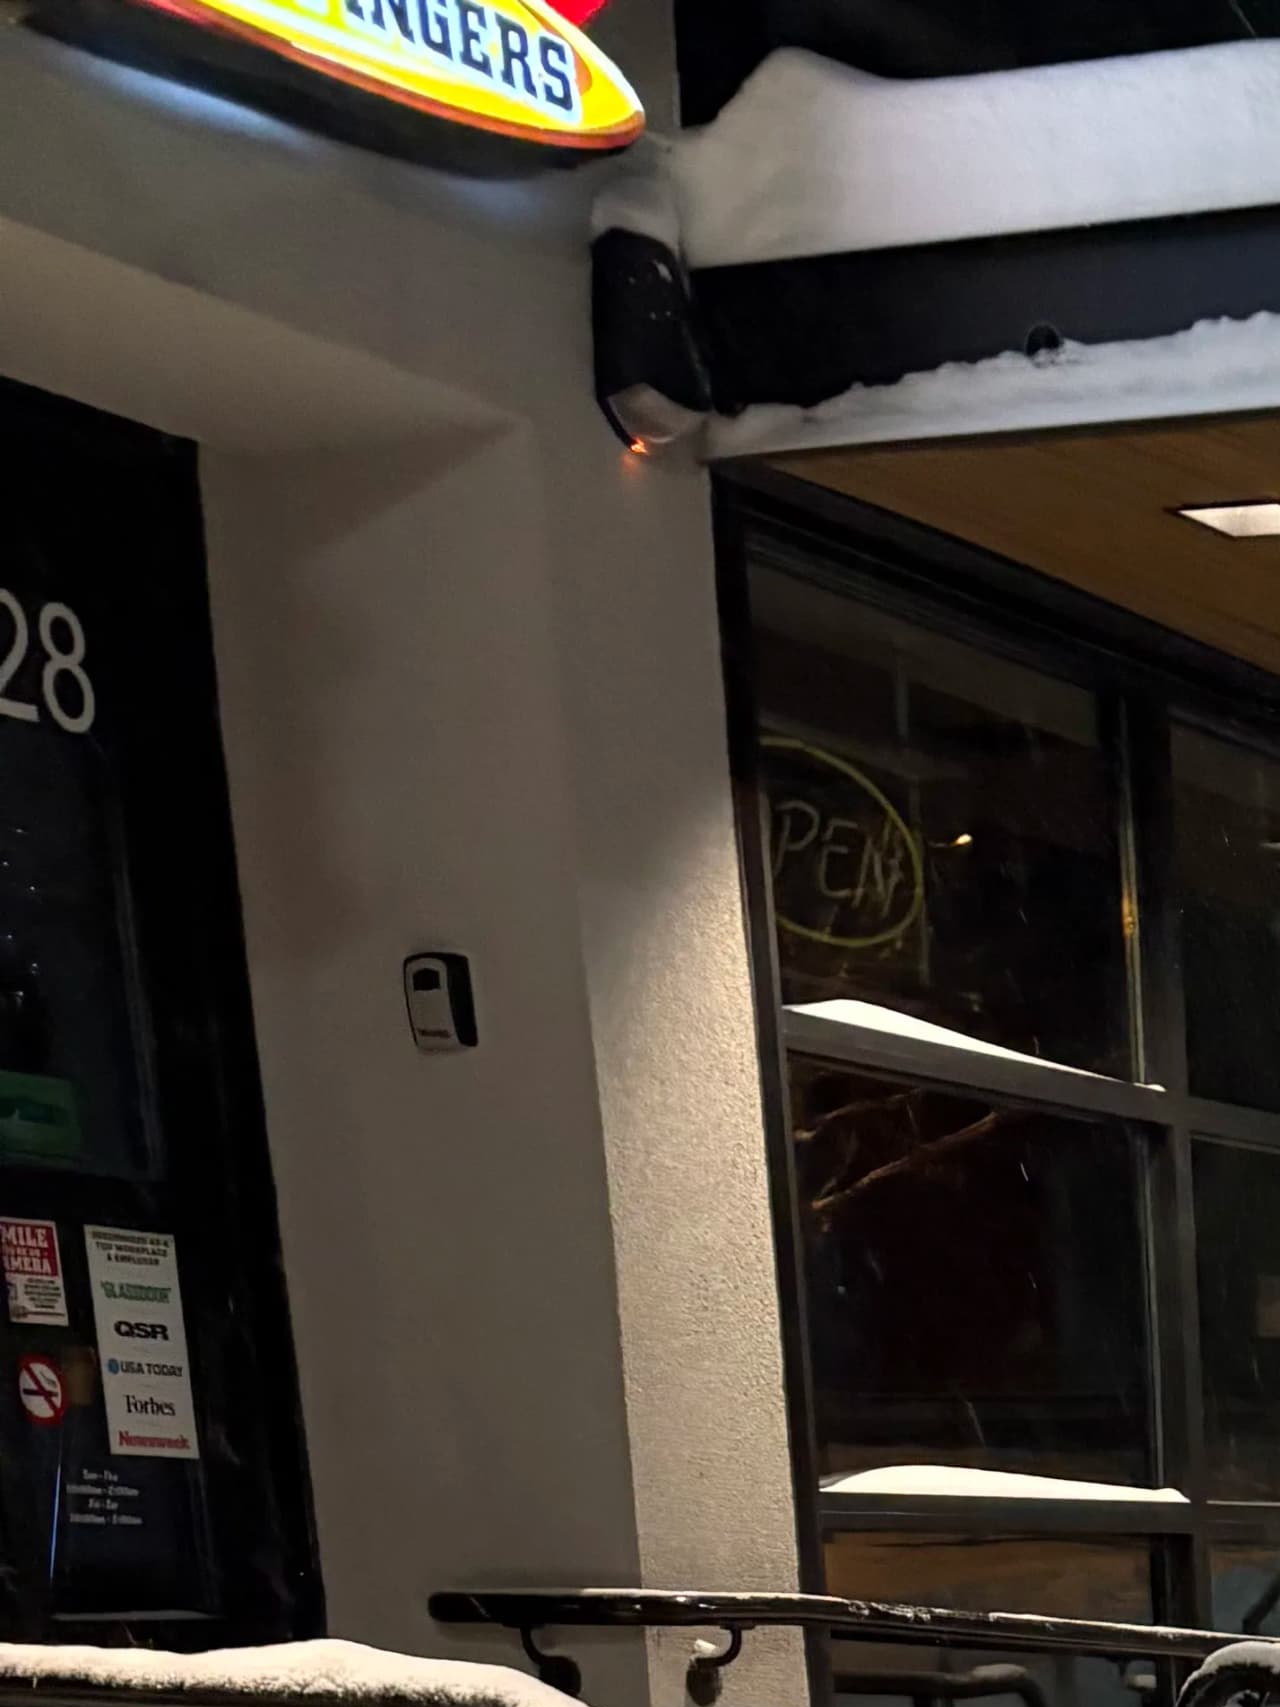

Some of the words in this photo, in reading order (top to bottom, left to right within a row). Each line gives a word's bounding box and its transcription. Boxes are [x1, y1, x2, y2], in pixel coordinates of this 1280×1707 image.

[346, 0, 574, 111] NGERS
[114, 1321, 169, 1341] QSR
[120, 1361, 144, 1374] USA
[146, 1363, 183, 1377] TODAY
[124, 1394, 176, 1416] Forbes
